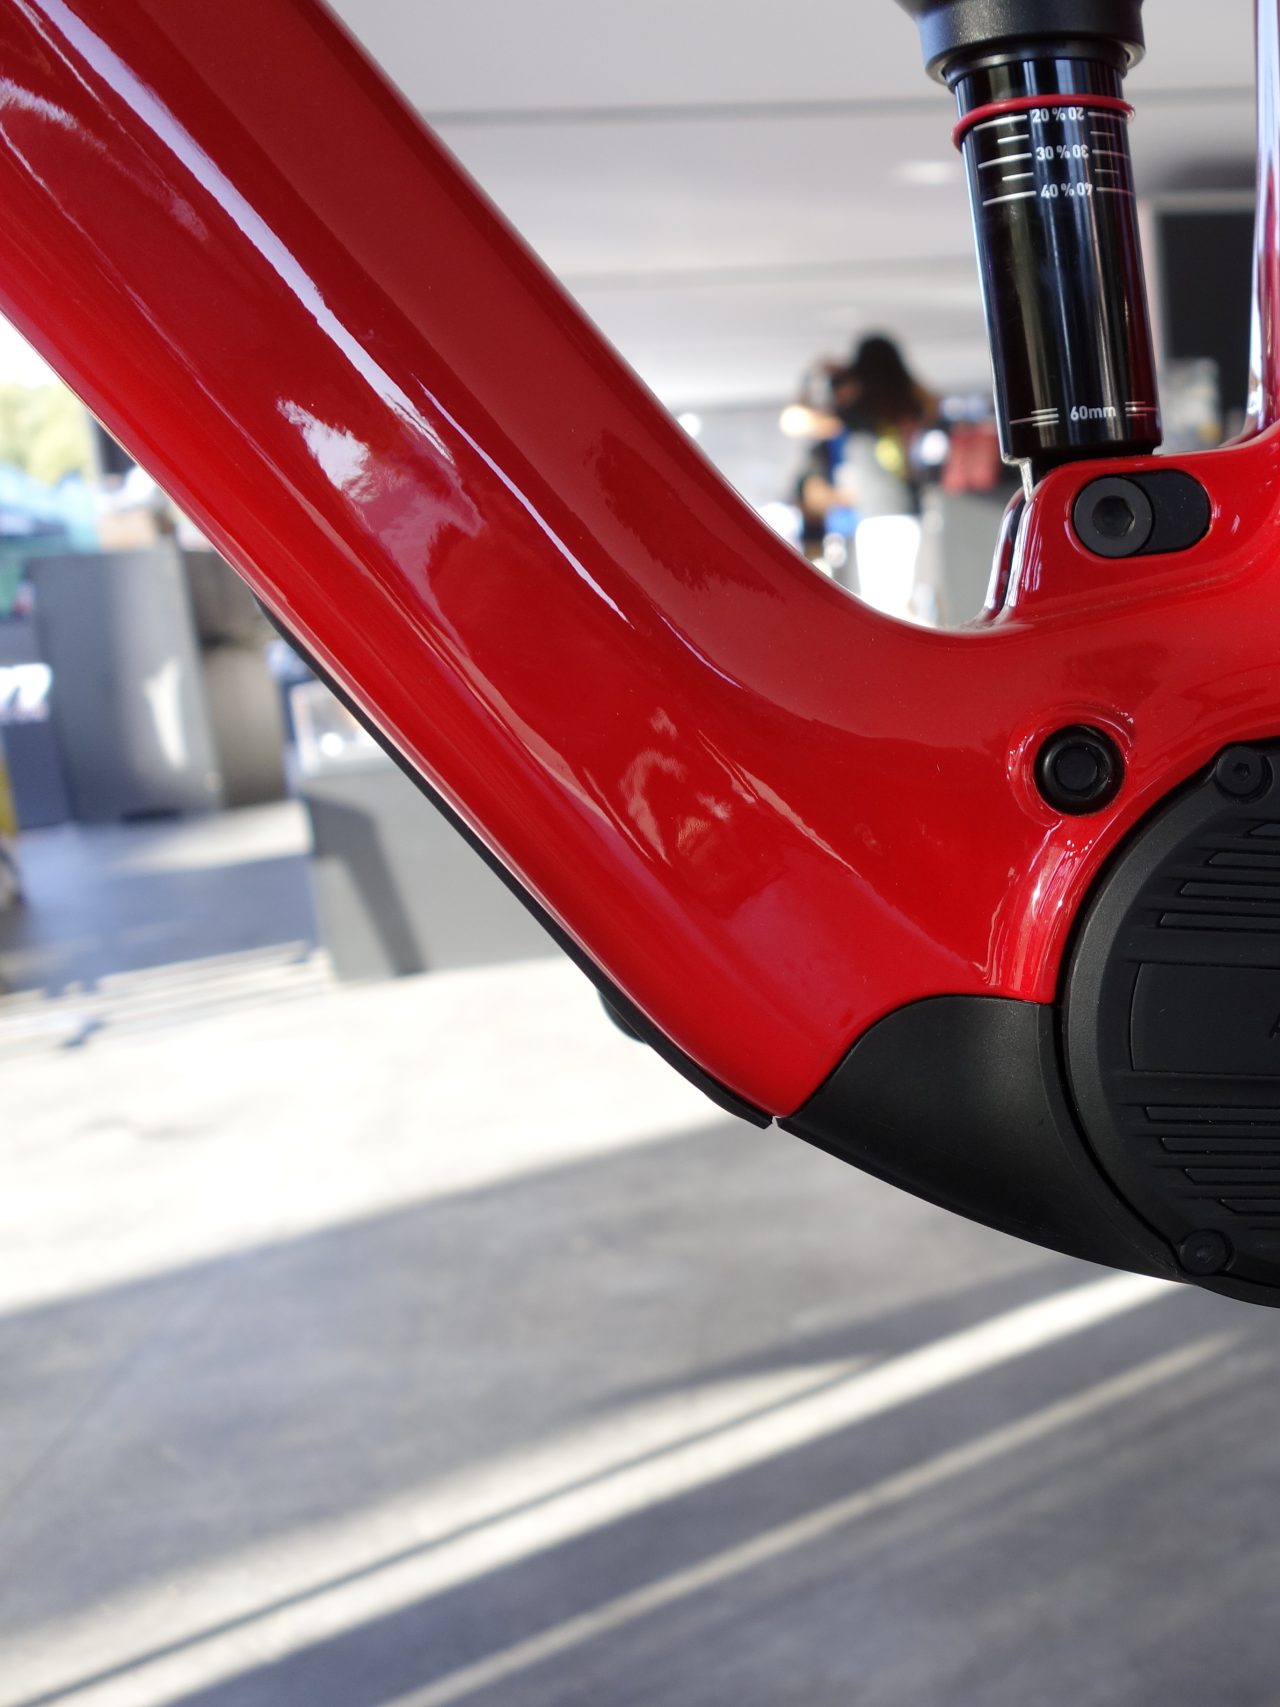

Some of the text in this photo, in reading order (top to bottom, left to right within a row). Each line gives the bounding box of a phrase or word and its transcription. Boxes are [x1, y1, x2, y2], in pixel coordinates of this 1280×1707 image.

[1036, 145, 1054, 161] 30
[1040, 183, 1059, 199] 40
[1070, 405, 1117, 421] 60mm
